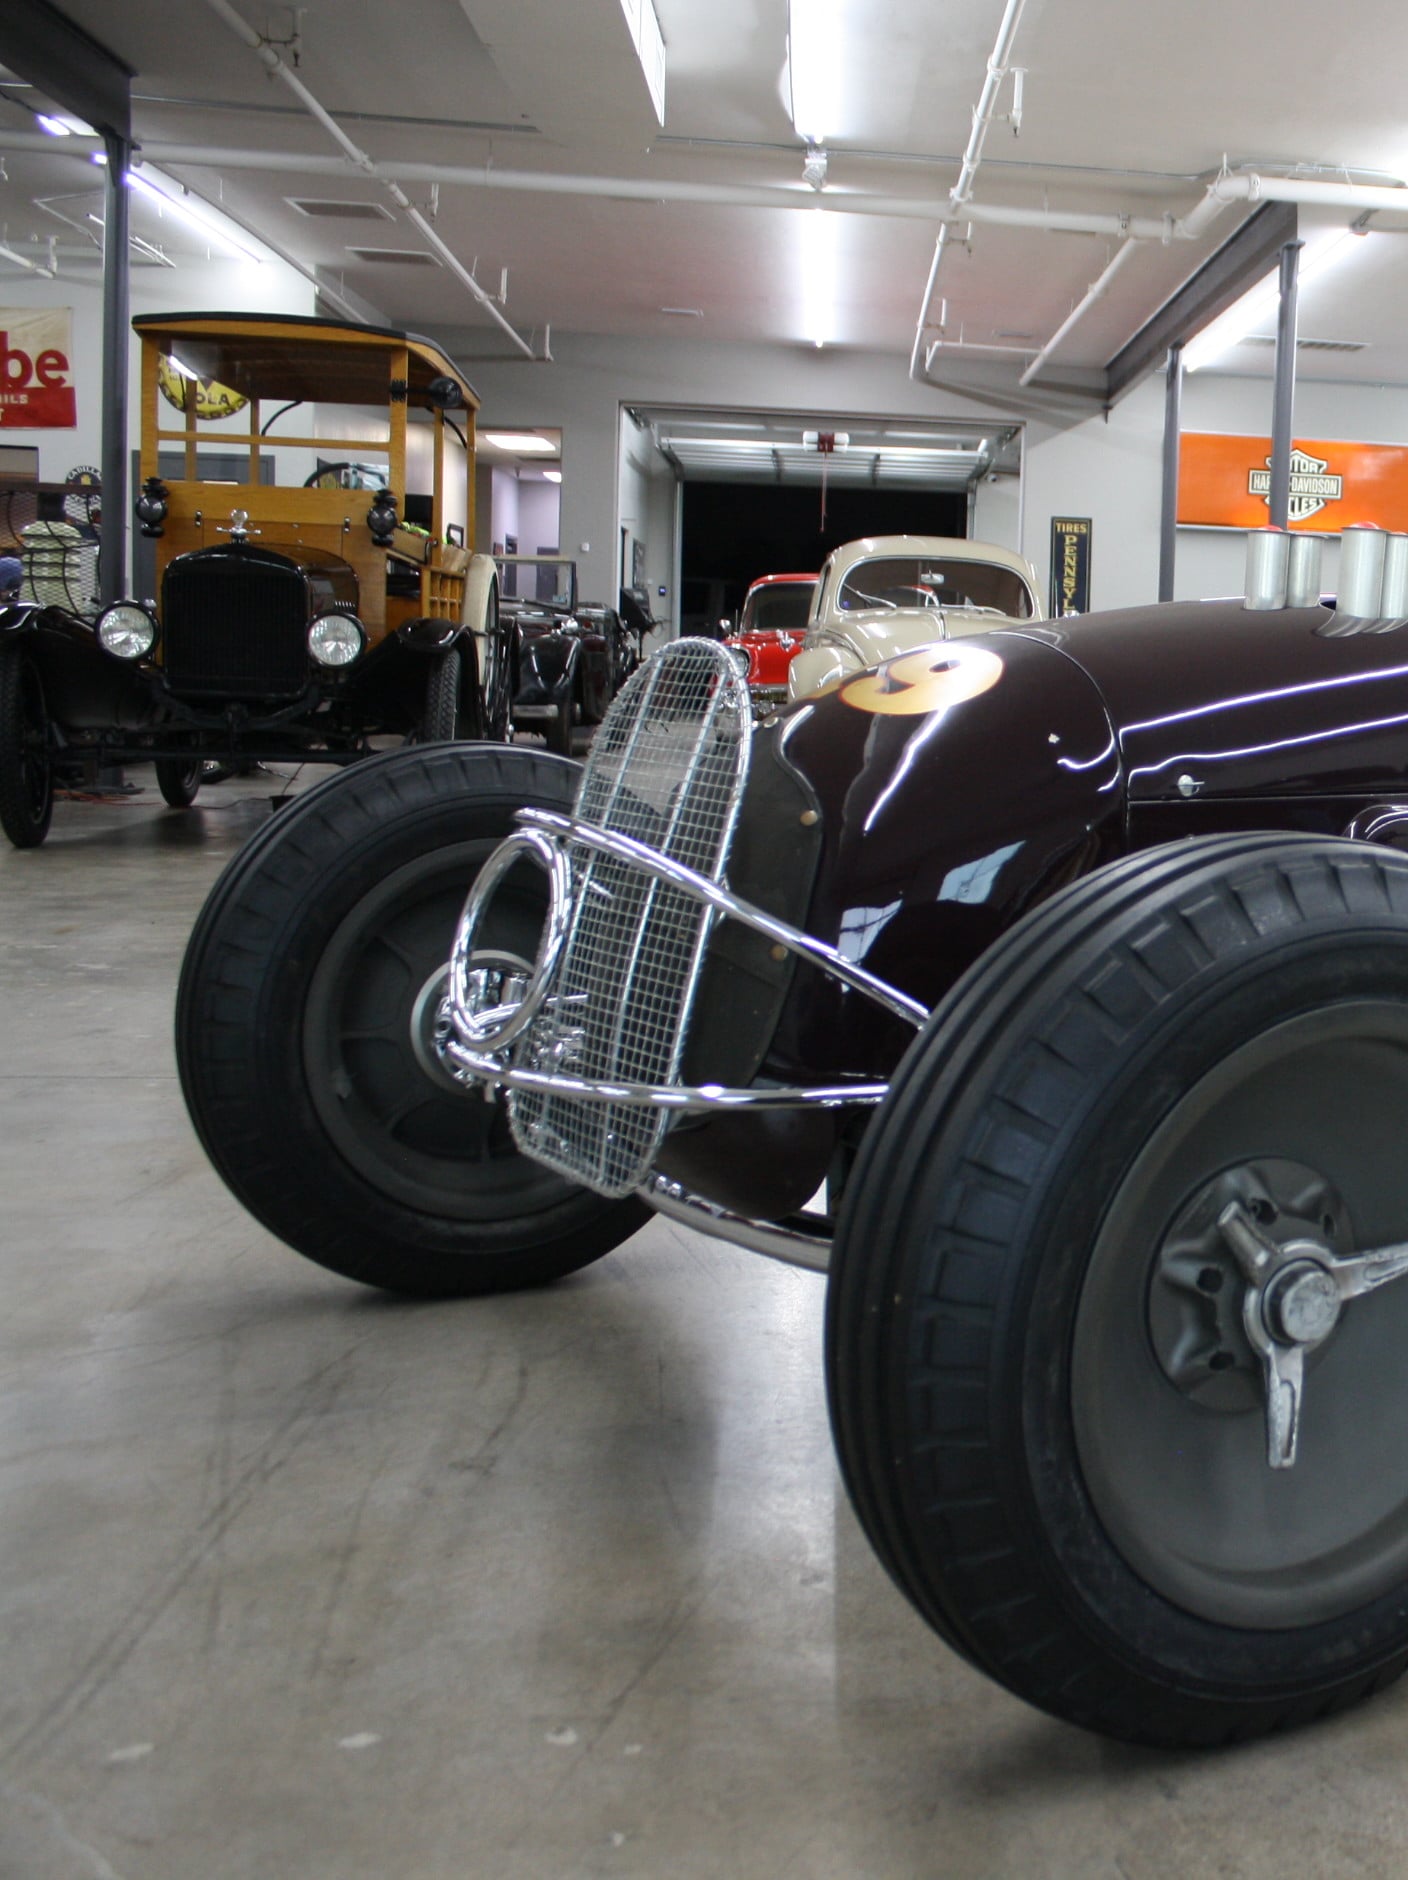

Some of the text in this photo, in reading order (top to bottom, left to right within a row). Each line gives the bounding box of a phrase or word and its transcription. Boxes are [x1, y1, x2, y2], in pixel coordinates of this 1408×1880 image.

[0, 394, 29, 404] ILS
[67, 465, 102, 480] CADILLA
[1055, 522, 1087, 533] TIRES
[1062, 534, 1078, 611] PENNSYL
